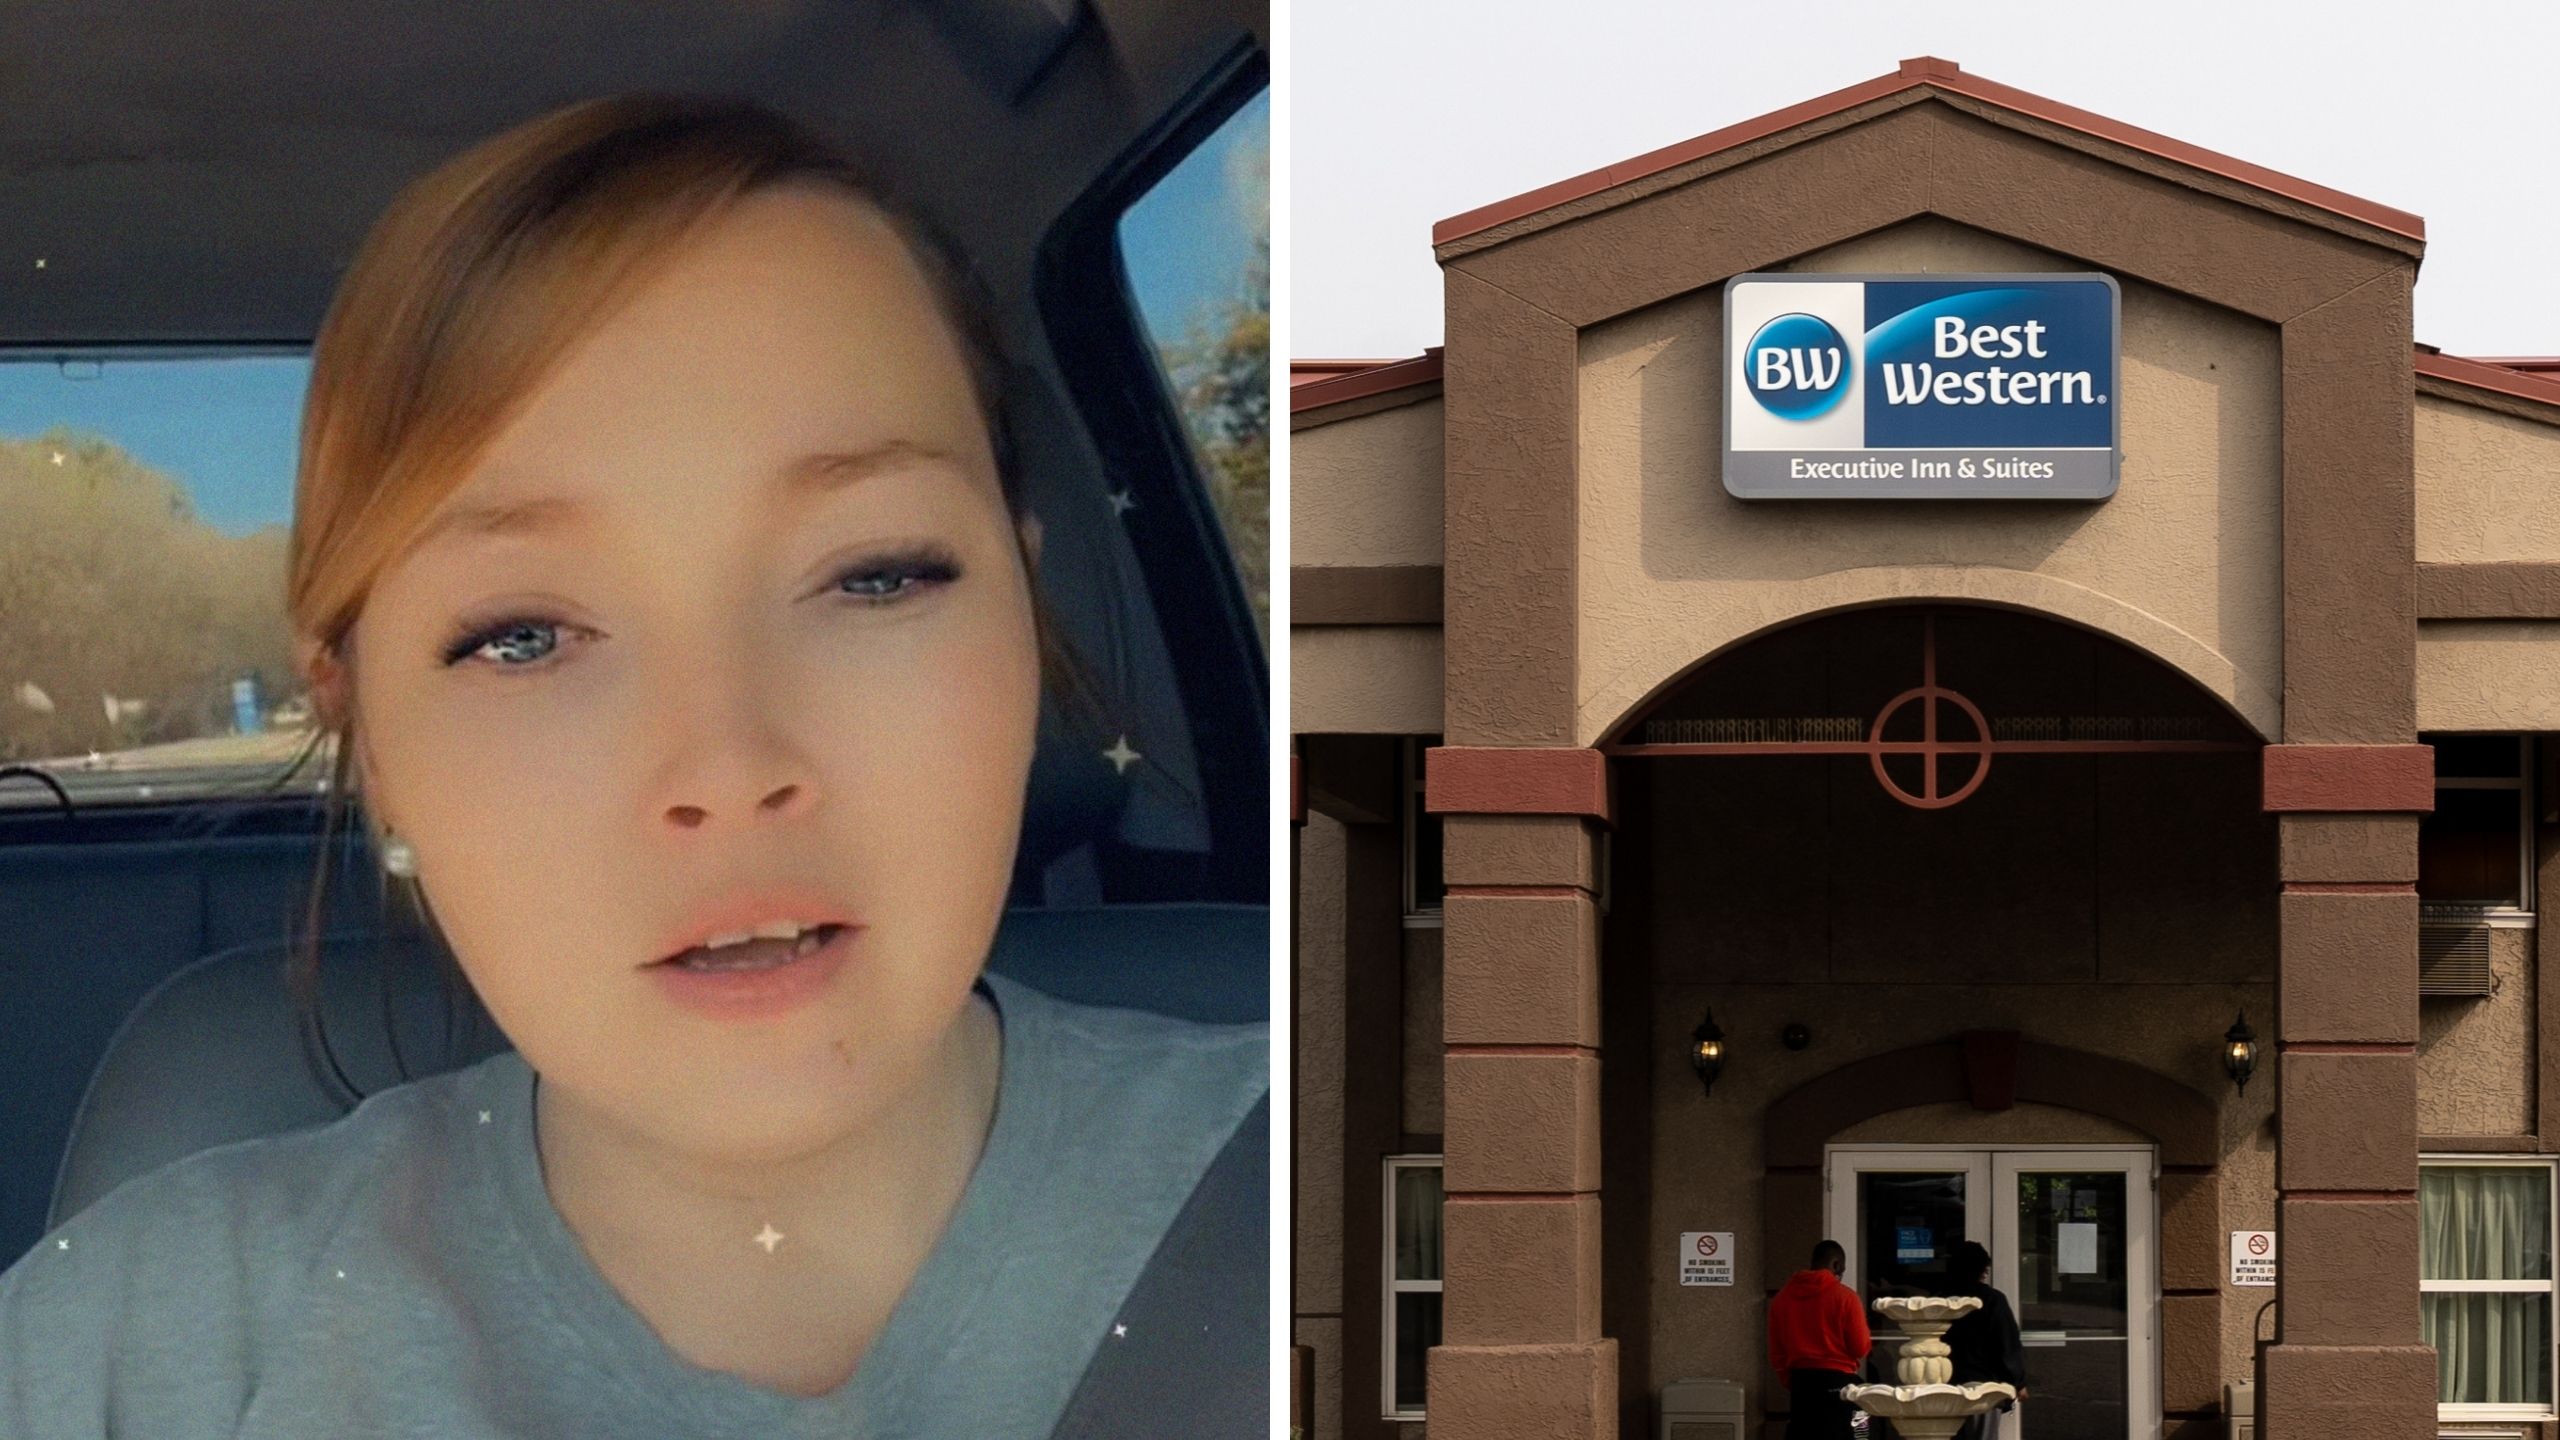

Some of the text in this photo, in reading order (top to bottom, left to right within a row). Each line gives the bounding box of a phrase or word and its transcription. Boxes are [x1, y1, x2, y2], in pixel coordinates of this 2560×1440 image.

[1934, 316, 2048, 359] Best
[1756, 346, 1842, 391] BW
[1790, 457, 2055, 479] Executive Inn & Suites
